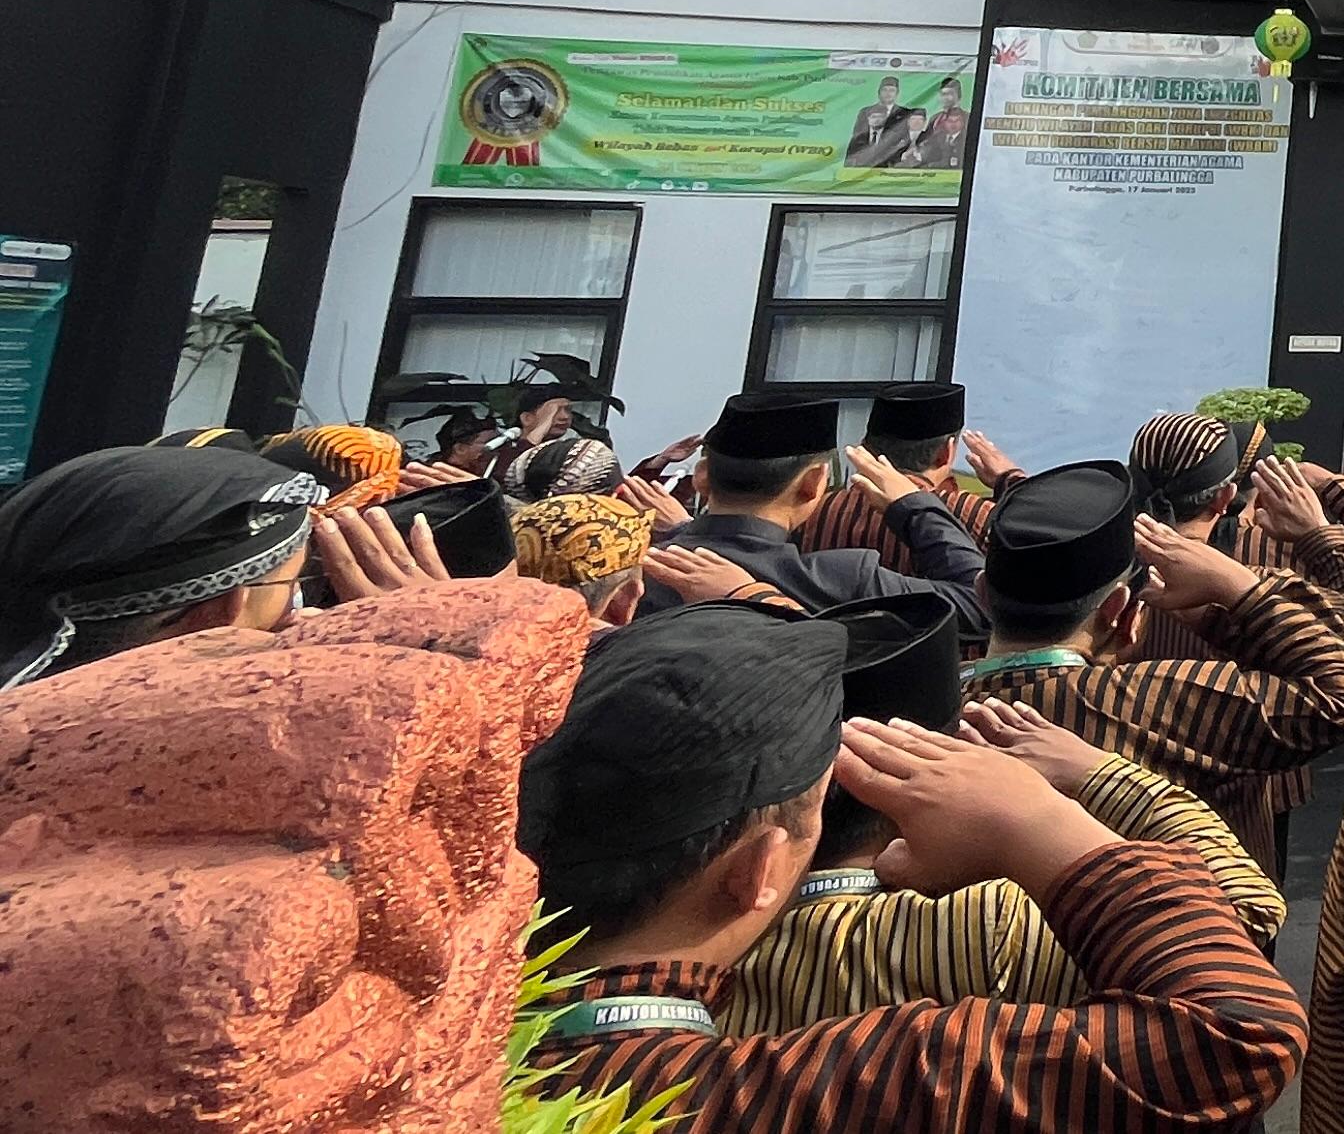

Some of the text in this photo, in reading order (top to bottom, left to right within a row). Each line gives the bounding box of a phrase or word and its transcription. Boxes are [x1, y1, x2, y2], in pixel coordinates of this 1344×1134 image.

[1022, 73, 1260, 105] KOMITMEN BERSAMA
[616, 92, 705, 109] Selamat
[753, 96, 825, 113] Sukses
[1026, 152, 1243, 169] PADA KANTOR KEMENTERIAN AGAMA
[1054, 168, 1213, 184] KABUPATEN PURBALINGGA
[595, 1004, 659, 1025] KANTOR
